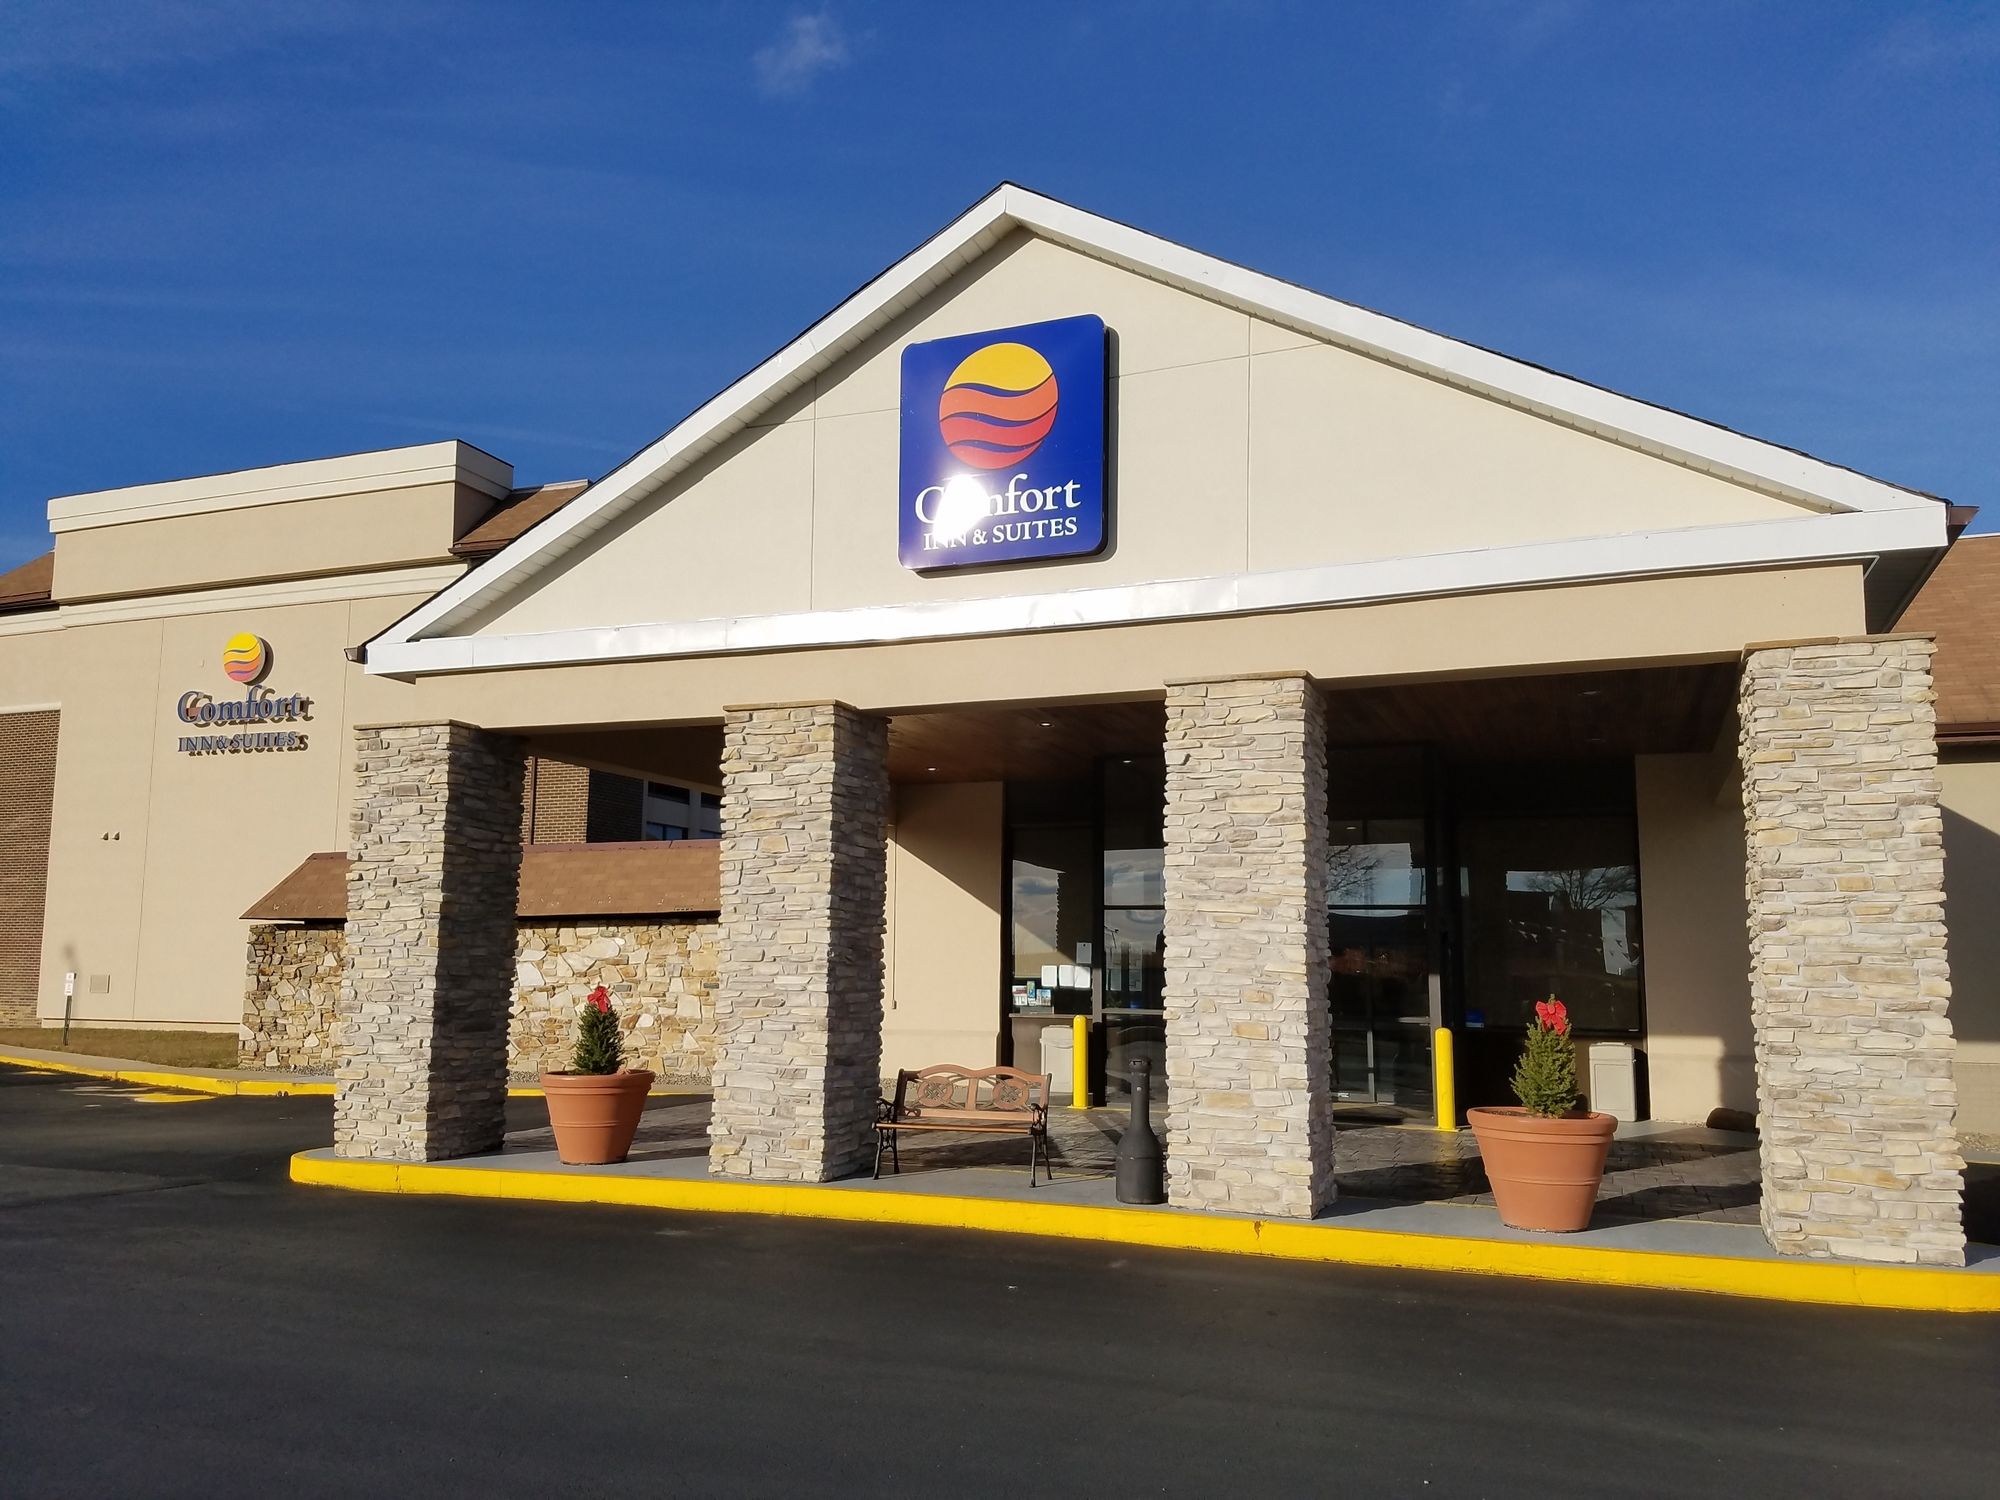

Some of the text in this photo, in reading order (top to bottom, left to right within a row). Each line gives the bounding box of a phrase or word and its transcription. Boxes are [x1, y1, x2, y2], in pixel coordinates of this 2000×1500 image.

[915, 473, 1082, 524] Cfort
[972, 528, 988, 545] &
[992, 516, 1078, 543] SUITES
[177, 684, 303, 723] Comfort
[178, 735, 215, 752] INN
[231, 731, 297, 748] SUITES
